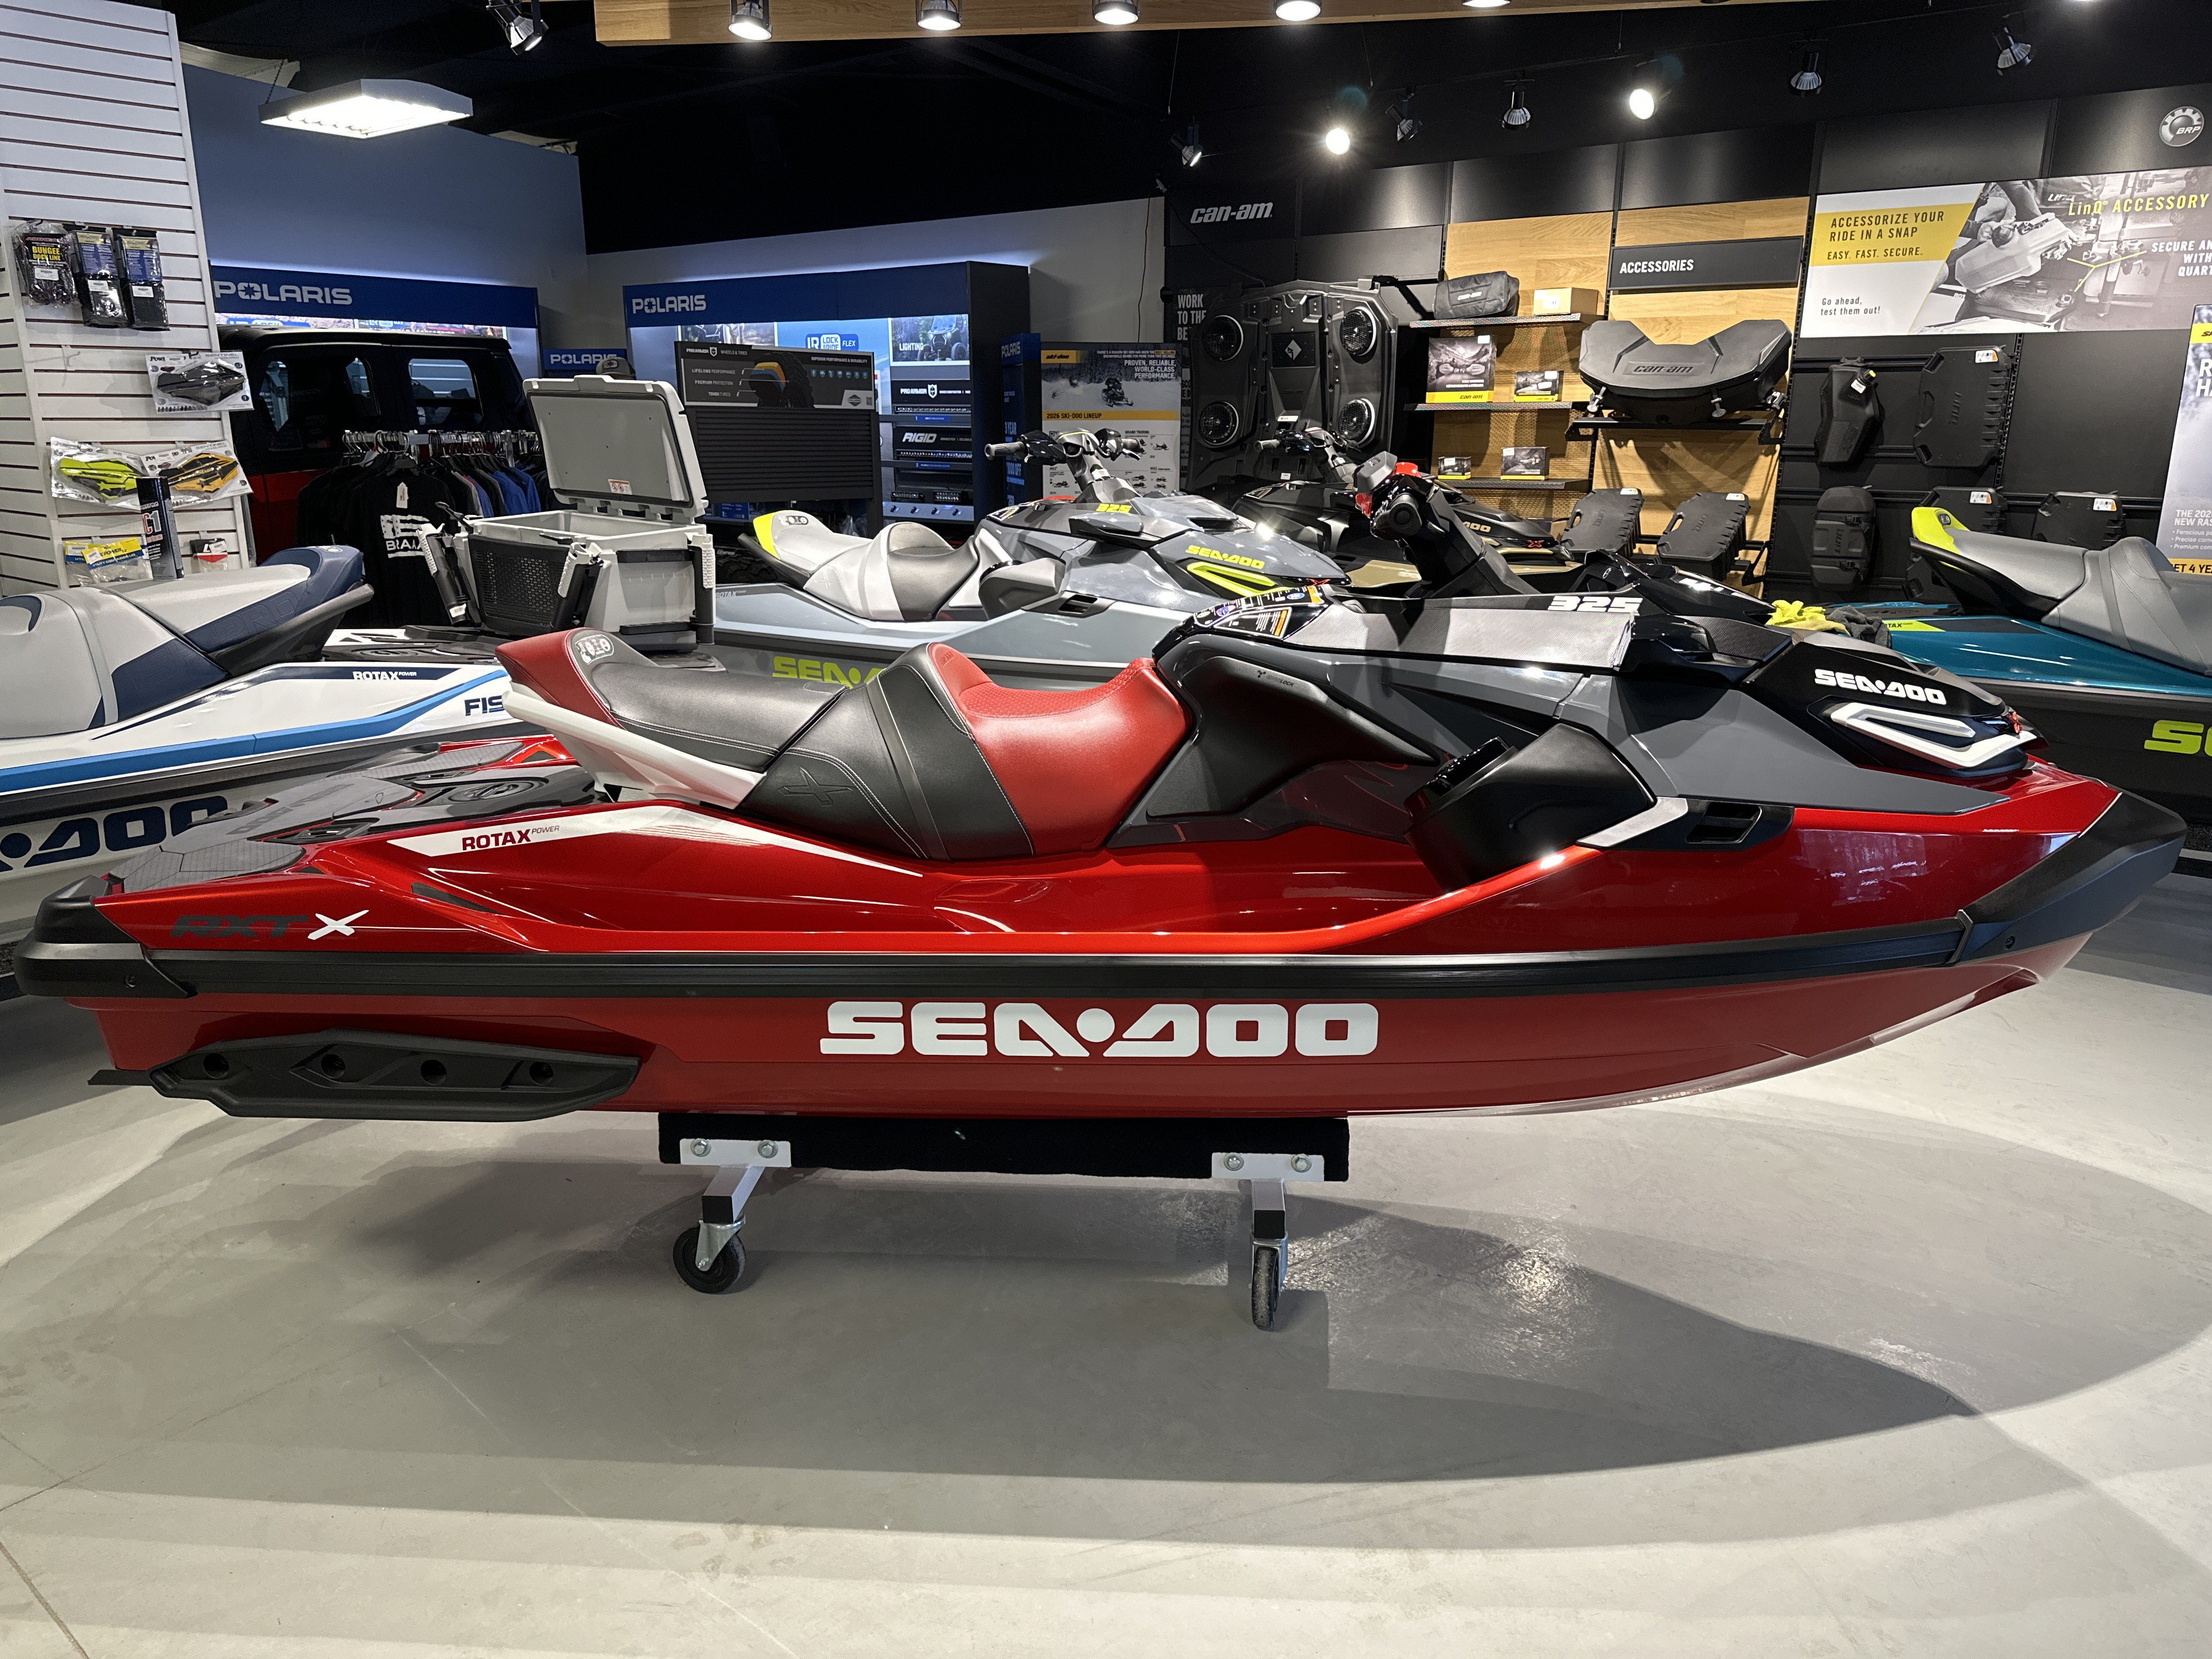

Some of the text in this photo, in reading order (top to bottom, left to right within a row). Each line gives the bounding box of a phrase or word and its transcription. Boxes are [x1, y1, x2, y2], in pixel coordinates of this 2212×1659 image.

[2176, 125, 2202, 136] BRP
[2112, 193, 2210, 213] ACCESSORY
[1190, 202, 1273, 224] can-am
[1831, 211, 1945, 228] ACCESSORIZE YOUR
[1830, 227, 1918, 242] RIDE IN A SNAP
[32, 246, 60, 255] BUNGEE
[1883, 247, 1923, 258] SECURE.
[2151, 240, 2194, 253] SECURE
[1620, 259, 1694, 274] ACCESSORIES
[215, 280, 353, 305] POLARIS
[632, 294, 707, 314] POLARIS
[1177, 294, 1204, 309] WORK
[1835, 297, 1863, 306] ahead,
[1864, 306, 1881, 314] out!
[1177, 310, 1206, 325] TO THE
[899, 342, 924, 351] LIGHTING
[1001, 341, 1020, 358] POLARIS
[1633, 363, 1694, 374] can-am
[1008, 421, 1017, 435] YEAR
[902, 432, 938, 443] RIGID
[1096, 503, 1132, 514] 325
[2194, 510, 2212, 518] 202
[2174, 518, 2195, 526] NEW
[2188, 564, 2196, 574] 4
[1548, 595, 1643, 613] 325
[352, 671, 400, 680] ROTAX
[462, 825, 560, 851] ROTAX POWER
[171, 915, 309, 938] RXT
